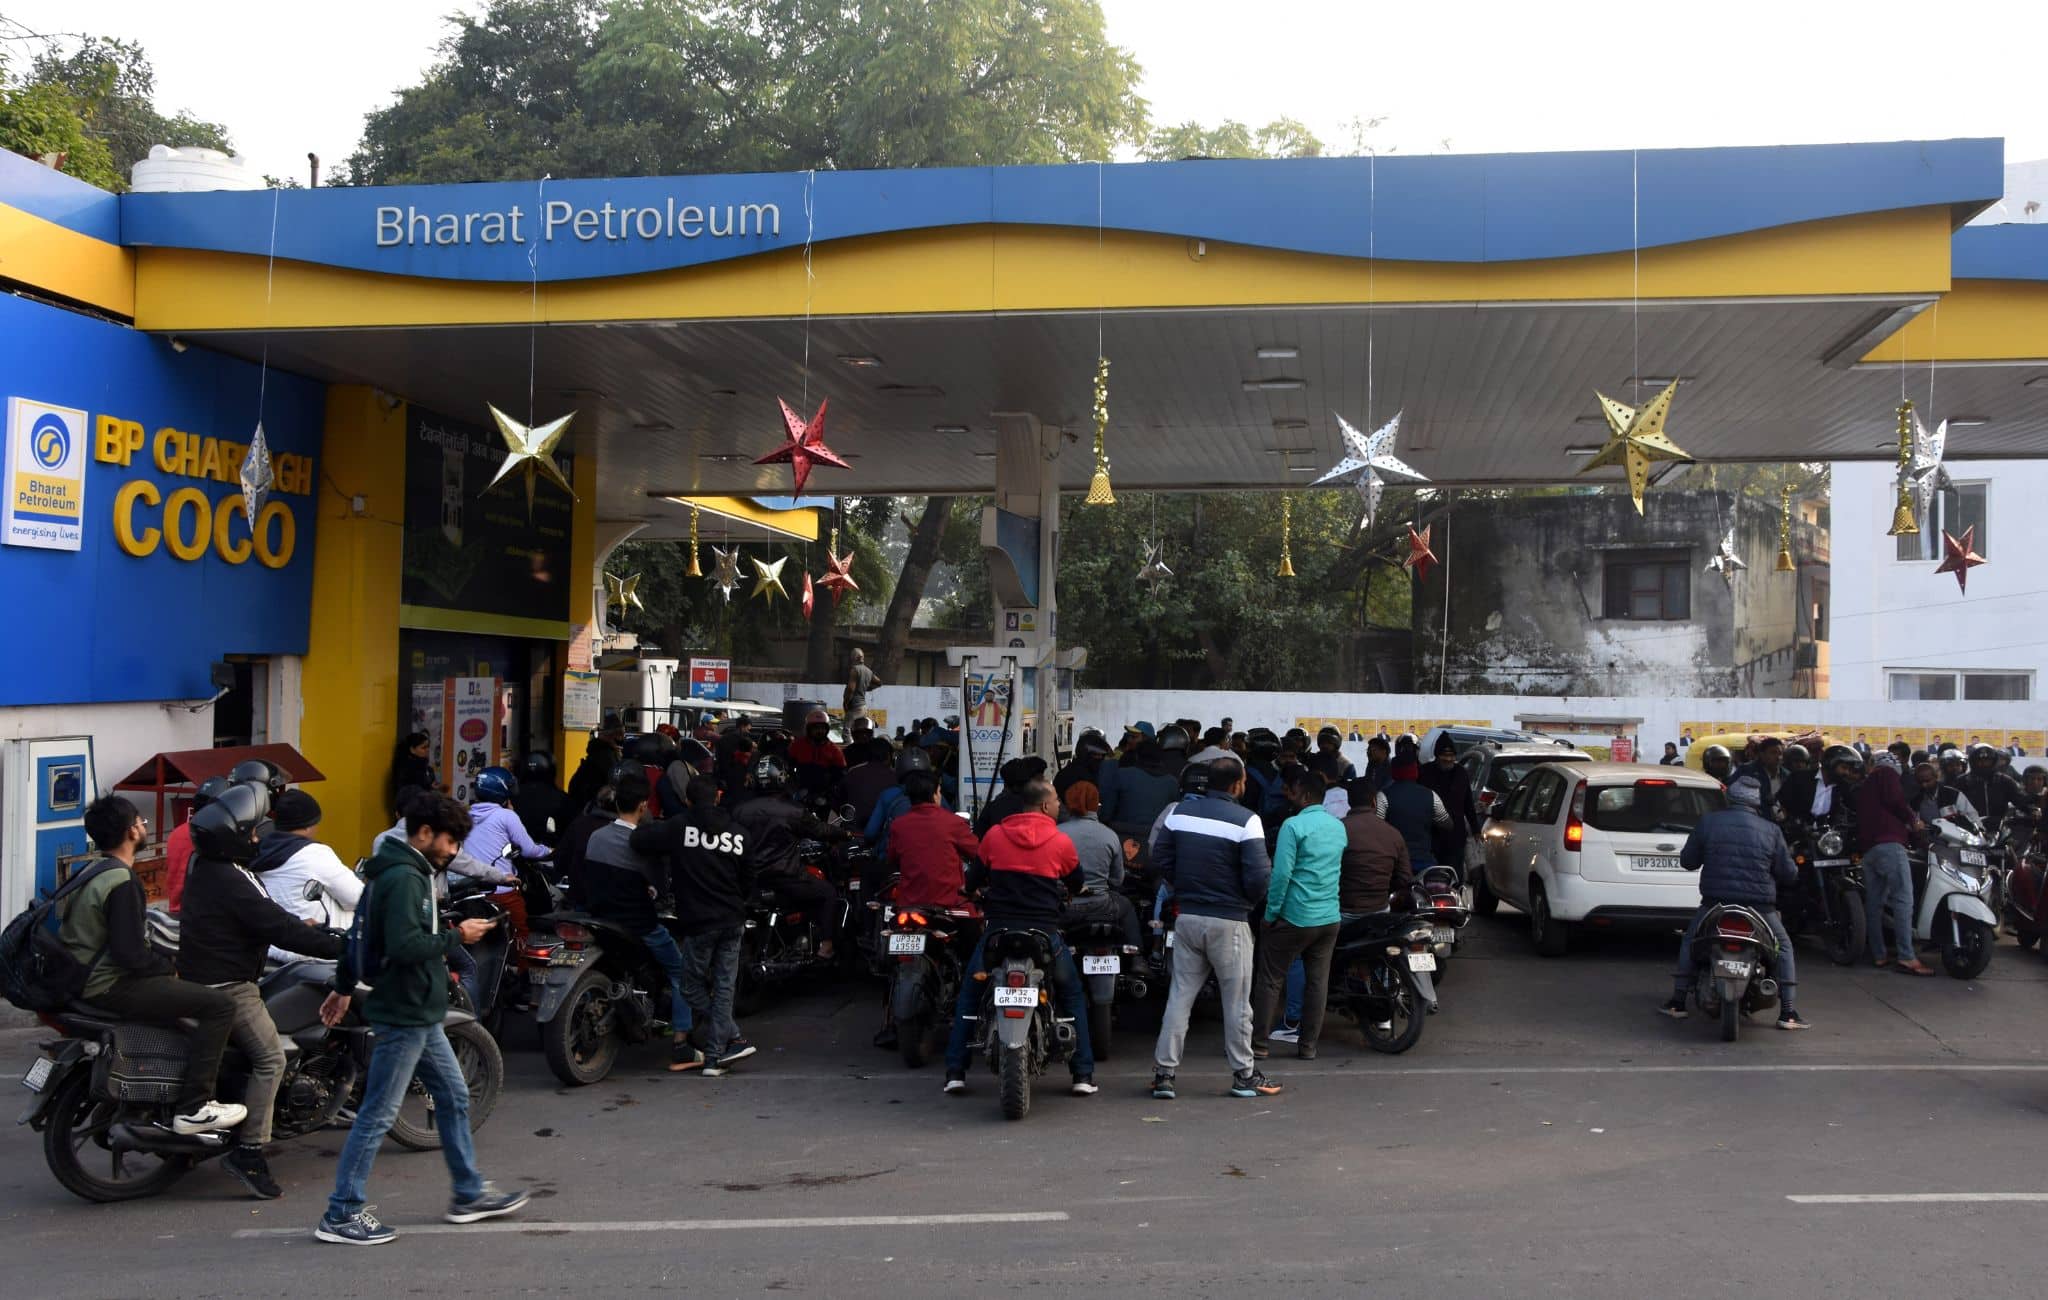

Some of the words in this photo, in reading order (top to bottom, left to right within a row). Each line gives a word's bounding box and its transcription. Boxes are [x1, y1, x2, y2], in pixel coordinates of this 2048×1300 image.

[376, 205, 524, 246] Bharat
[545, 198, 780, 241] Petroleum
[94, 414, 145, 467] BP
[153, 427, 313, 496] CHARGH
[29, 480, 67, 497] Bharat
[19, 492, 76, 510] Petroleum
[12, 527, 57, 541] energising
[59, 527, 80, 541] lives
[113, 479, 296, 569] COCO
[684, 826, 744, 856] BOSS
[999, 996, 1010, 1004] GR
